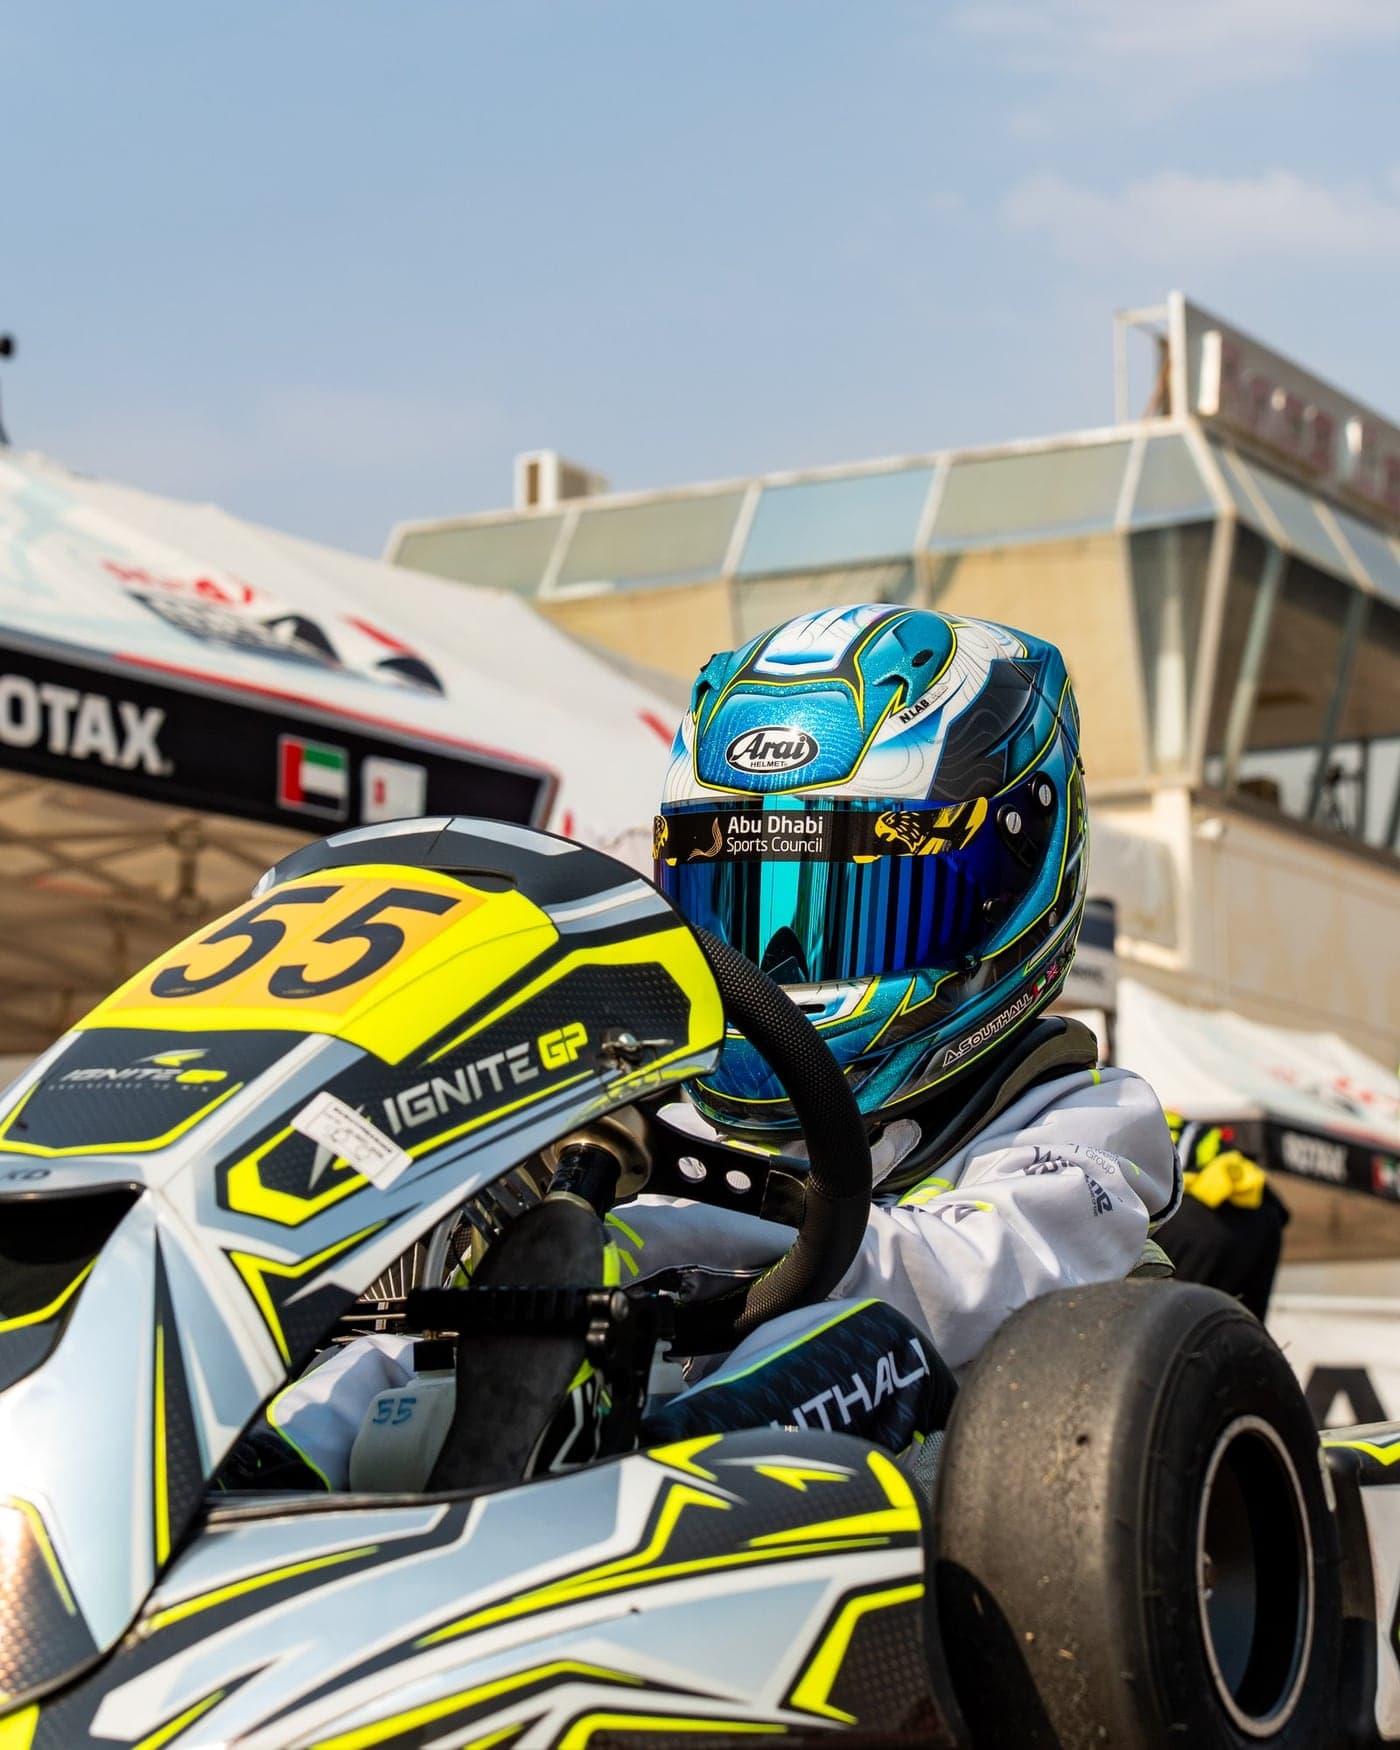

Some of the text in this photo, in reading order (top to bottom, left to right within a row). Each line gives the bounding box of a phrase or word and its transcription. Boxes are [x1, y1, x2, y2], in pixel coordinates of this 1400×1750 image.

[731, 732, 808, 761] Arai
[728, 815, 824, 834] Abu Dhabi
[726, 836, 823, 855] Sports Council
[150, 885, 462, 1000] 55
[383, 1041, 540, 1136] IGNITE
[536, 1021, 589, 1071] GP
[1085, 1148, 1116, 1176] Group
[372, 1397, 417, 1425] 55
